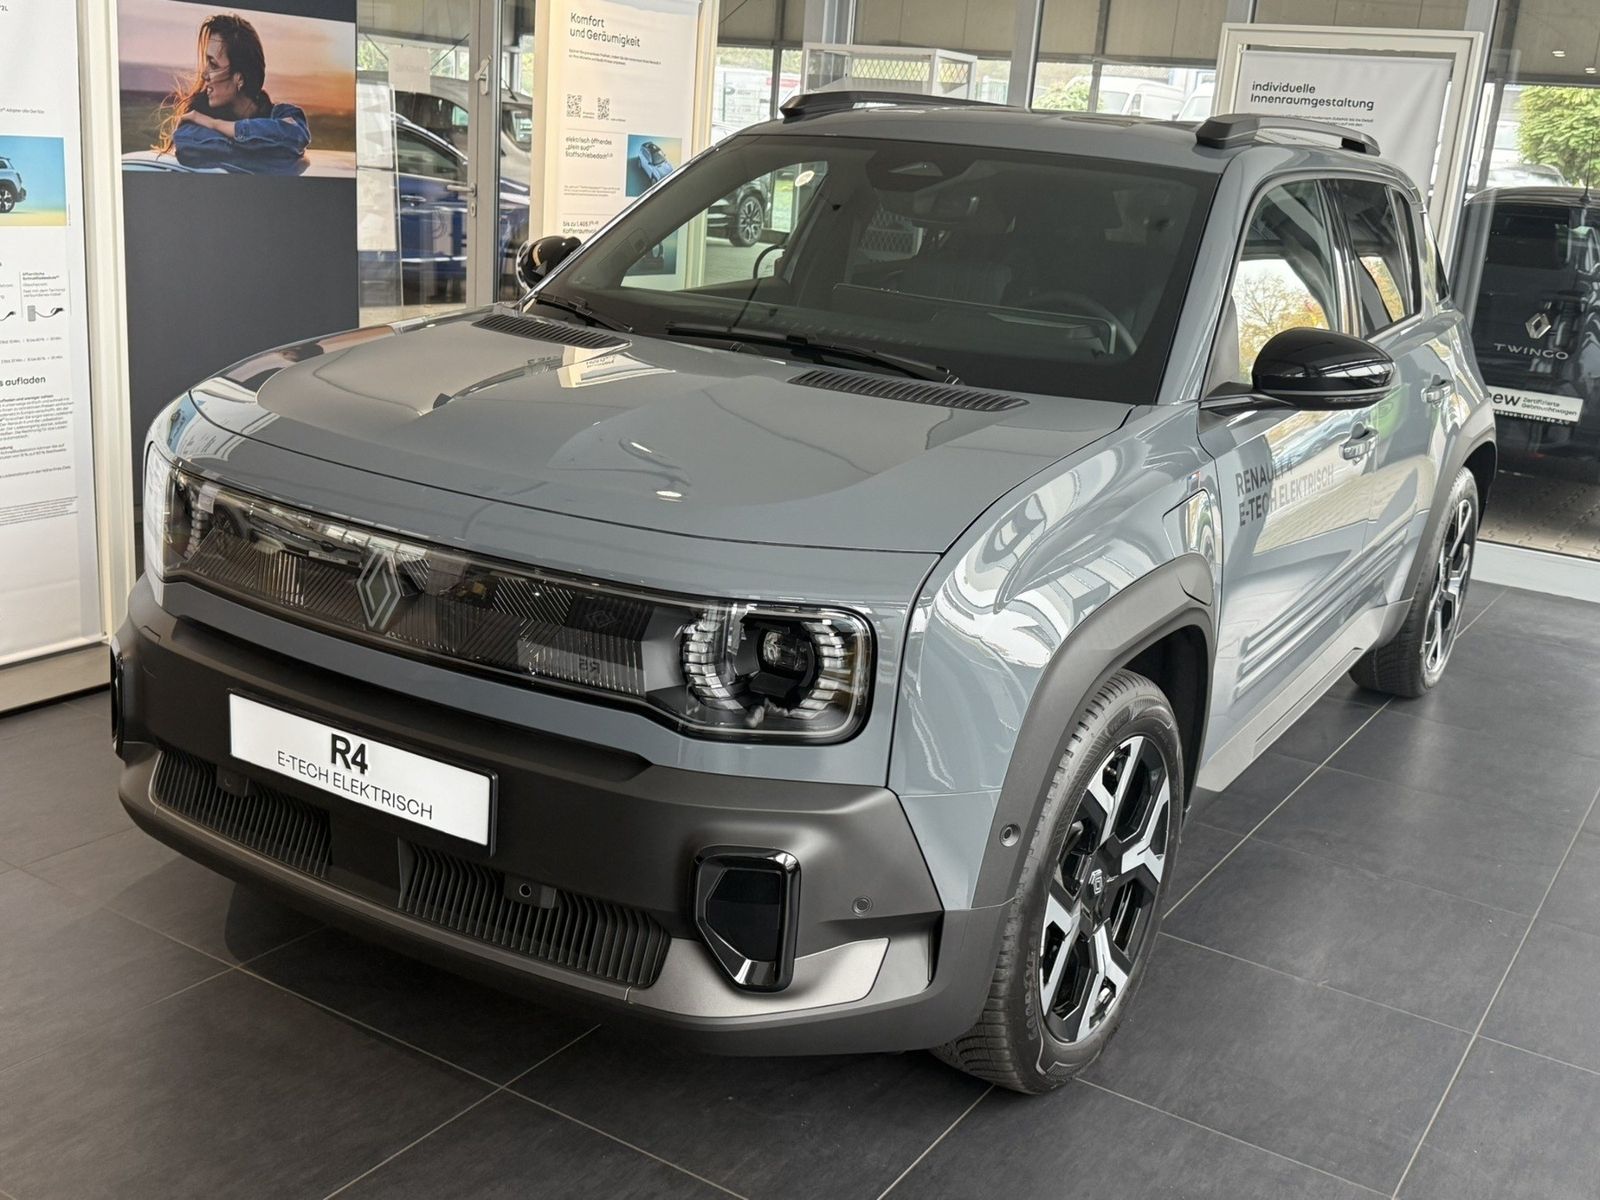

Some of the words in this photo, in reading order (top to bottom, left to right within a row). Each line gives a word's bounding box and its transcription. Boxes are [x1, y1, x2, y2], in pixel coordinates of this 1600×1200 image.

[570, 12, 605, 28] Komfort
[570, 28, 585, 39] und
[586, 29, 640, 47] Geräumigkeit
[1252, 81, 1316, 93] individuelle
[1250, 94, 1374, 111] Innenraumgestaltung
[1493, 343, 1569, 360] TWINGO
[5, 376, 46, 386] aufladen
[1239, 487, 1277, 527] E-TECH
[1279, 463, 1334, 506] ELEKTRISCH
[331, 733, 368, 775] R4
[277, 750, 329, 784] E-TECH
[333, 772, 433, 820] ELEKTRISCH
